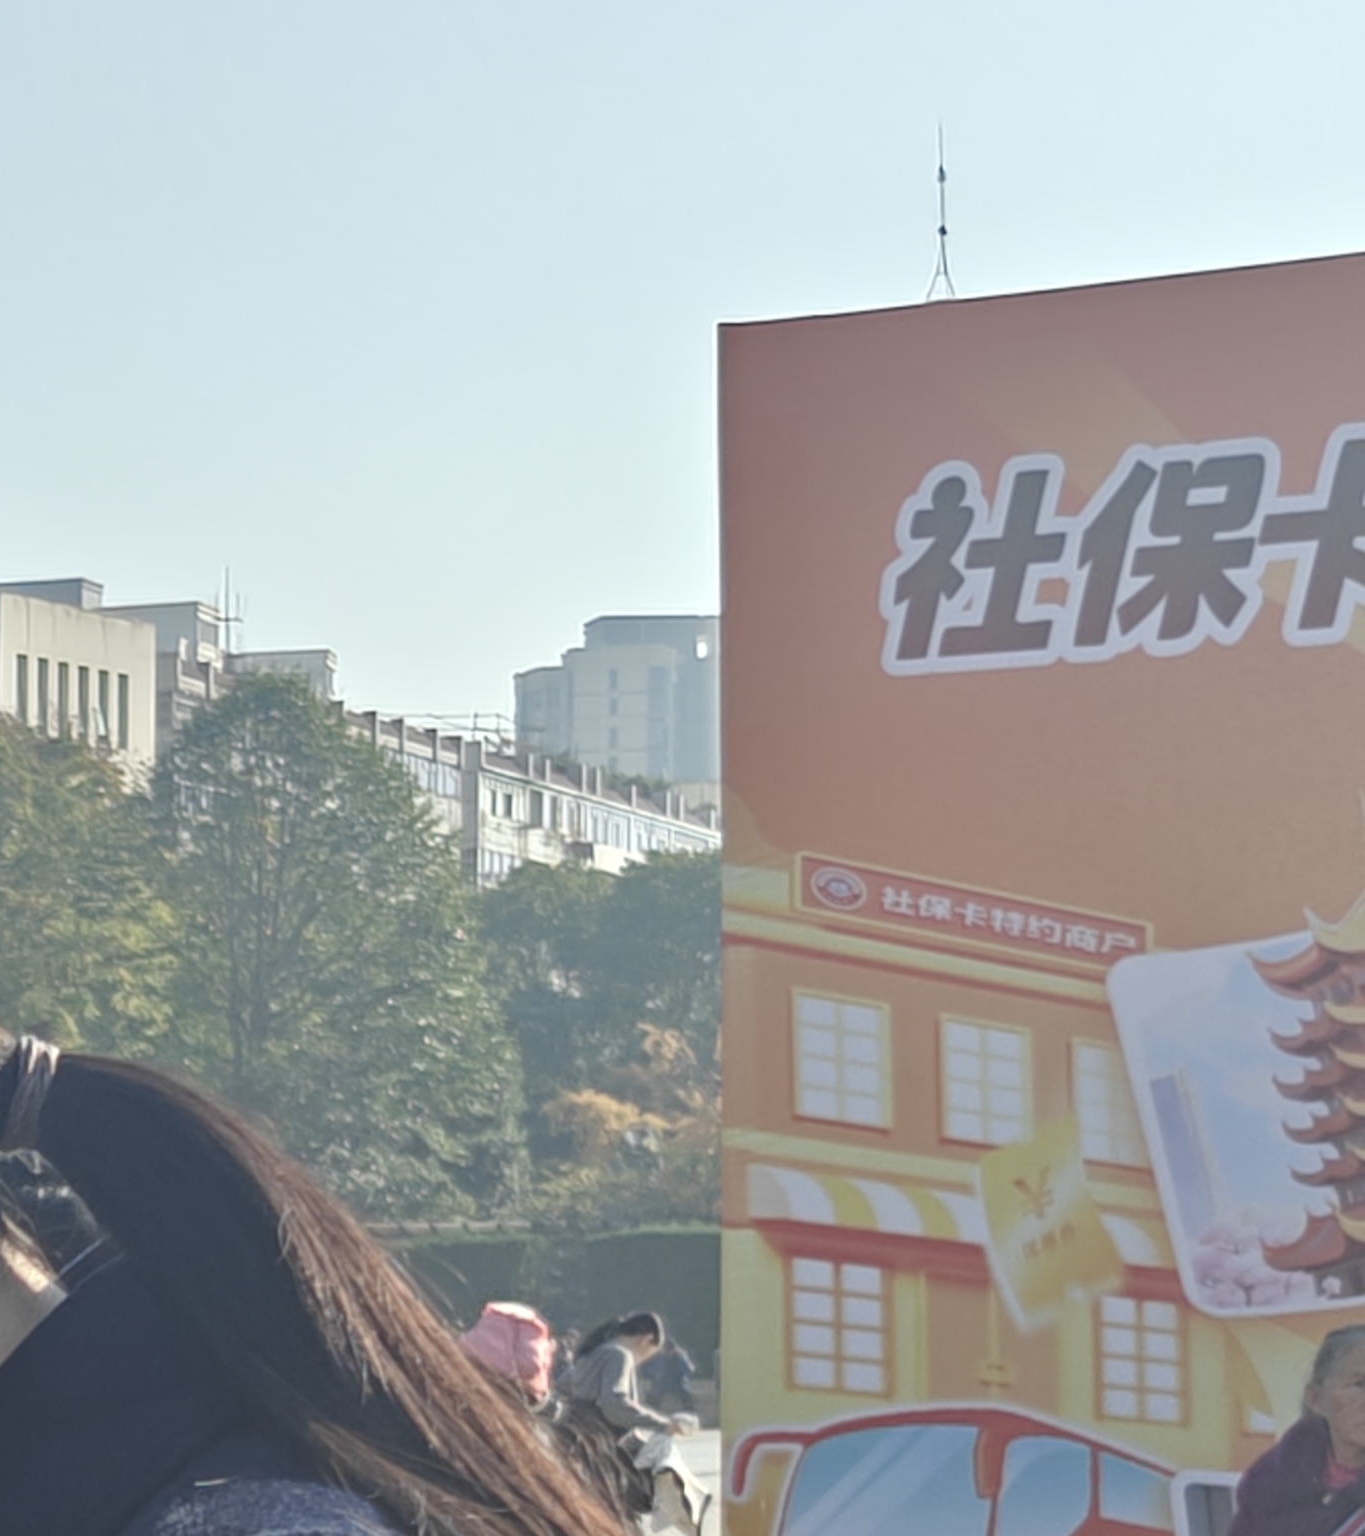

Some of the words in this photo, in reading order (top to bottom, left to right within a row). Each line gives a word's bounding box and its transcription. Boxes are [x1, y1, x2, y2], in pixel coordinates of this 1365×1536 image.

[880, 423, 1365, 675] 社保卡
[880, 884, 1137, 953] 社保卡特约商户
